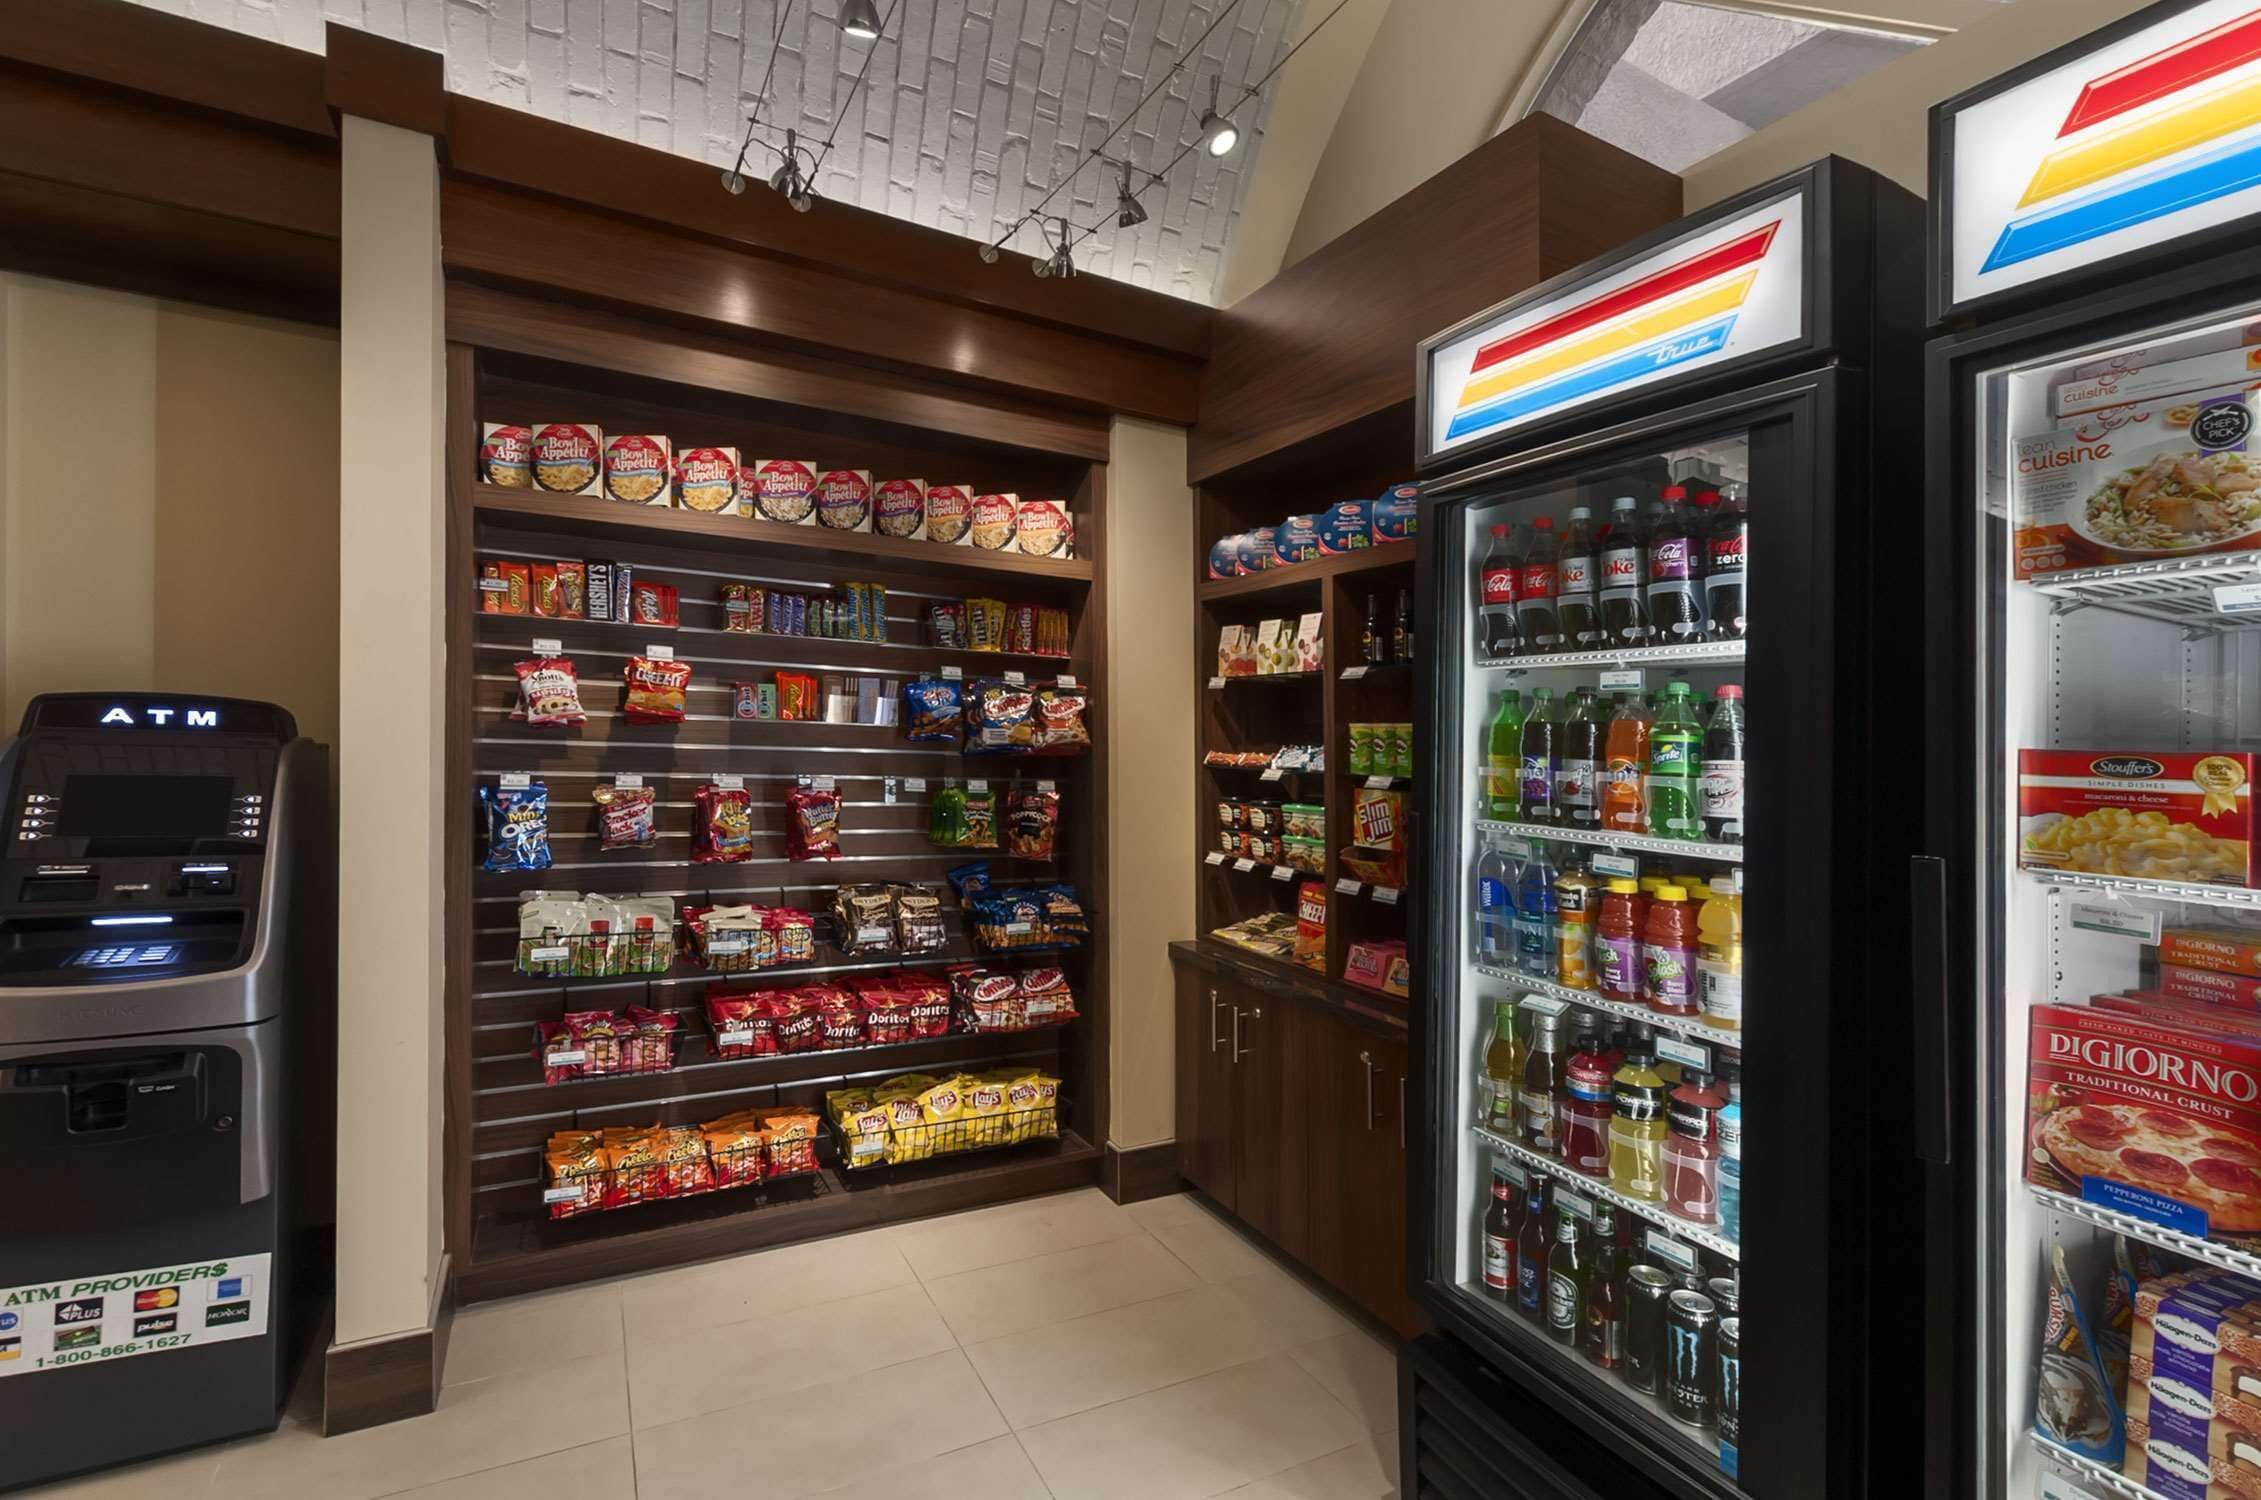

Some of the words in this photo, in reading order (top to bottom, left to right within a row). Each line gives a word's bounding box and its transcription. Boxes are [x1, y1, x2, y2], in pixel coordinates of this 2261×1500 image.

[1648, 335, 1713, 364] True
[2064, 384, 2119, 403] cuisine
[2209, 427, 2236, 440] PICK
[549, 437, 578, 450] Bowl
[620, 448, 648, 461] Bowl
[2018, 443, 2113, 473] cuisine
[693, 460, 718, 473] Bowl
[771, 471, 799, 483] Bowl
[101, 707, 217, 726] ATM
[1652, 749, 1682, 763] Sprite
[2098, 760, 2154, 776] Stouffer's
[2087, 779, 2123, 788] SIMPLE
[2127, 780, 2167, 790] DISHES
[2084, 793, 2128, 802] macaroni
[2137, 794, 2169, 804] cheese
[2171, 951, 2241, 968] TRADITIONAL
[2169, 983, 2239, 1002] TRADITIONAL
[2050, 1033, 2257, 1102] DIGIORNO
[2066, 1071, 2174, 1104] TRADITIONAL
[2177, 1096, 2235, 1120] CRUST
[2103, 1183, 2153, 1205] PEPPERONI
[2156, 1200, 2185, 1216] PIZZA
[4, 1286, 62, 1307] ATM
[69, 1307, 102, 1321] PLUS
[35, 1333, 193, 1368] 1-800-866-1627
